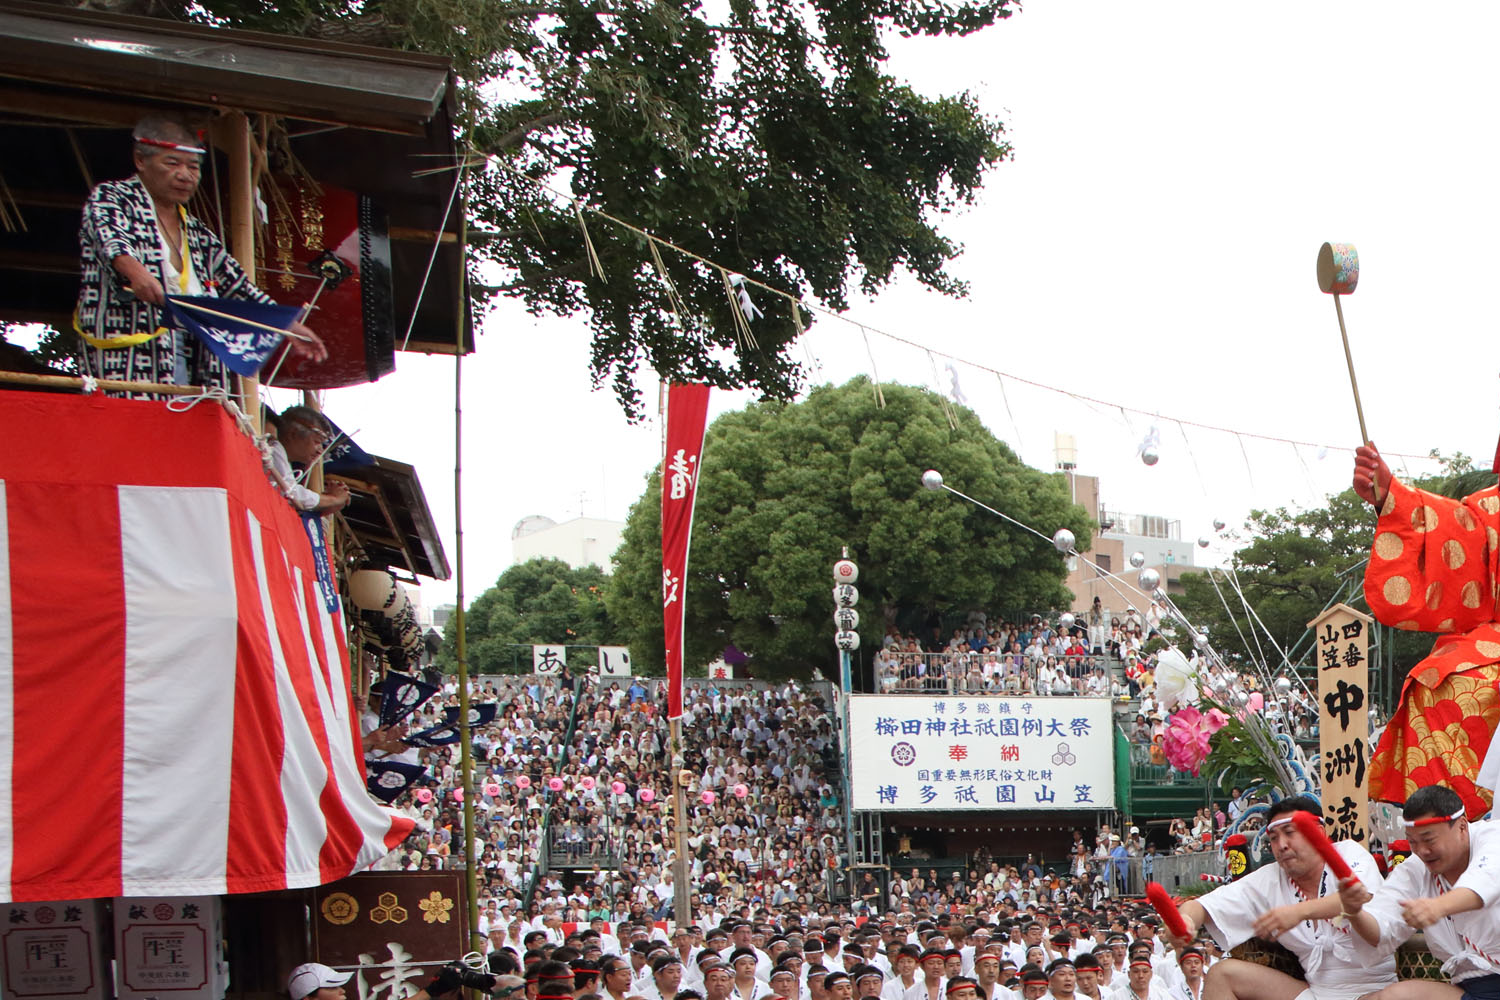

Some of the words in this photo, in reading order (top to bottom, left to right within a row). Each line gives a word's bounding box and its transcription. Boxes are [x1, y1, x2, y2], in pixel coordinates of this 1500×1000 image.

[1320, 624, 1342, 671] 山笠
[1342, 619, 1365, 669] 四番
[538, 648, 563, 674] あ
[603, 651, 629, 674] い
[933, 702, 1033, 715] 博多総鎮守
[875, 717, 1092, 738] 櫛田神社祇園例大祭
[948, 744, 1020, 762] 奉納
[1324, 679, 1366, 844] 中洲流
[917, 769, 1053, 782] 国重要無形民俗文化財
[876, 784, 1095, 804] 博多祇園山笠
